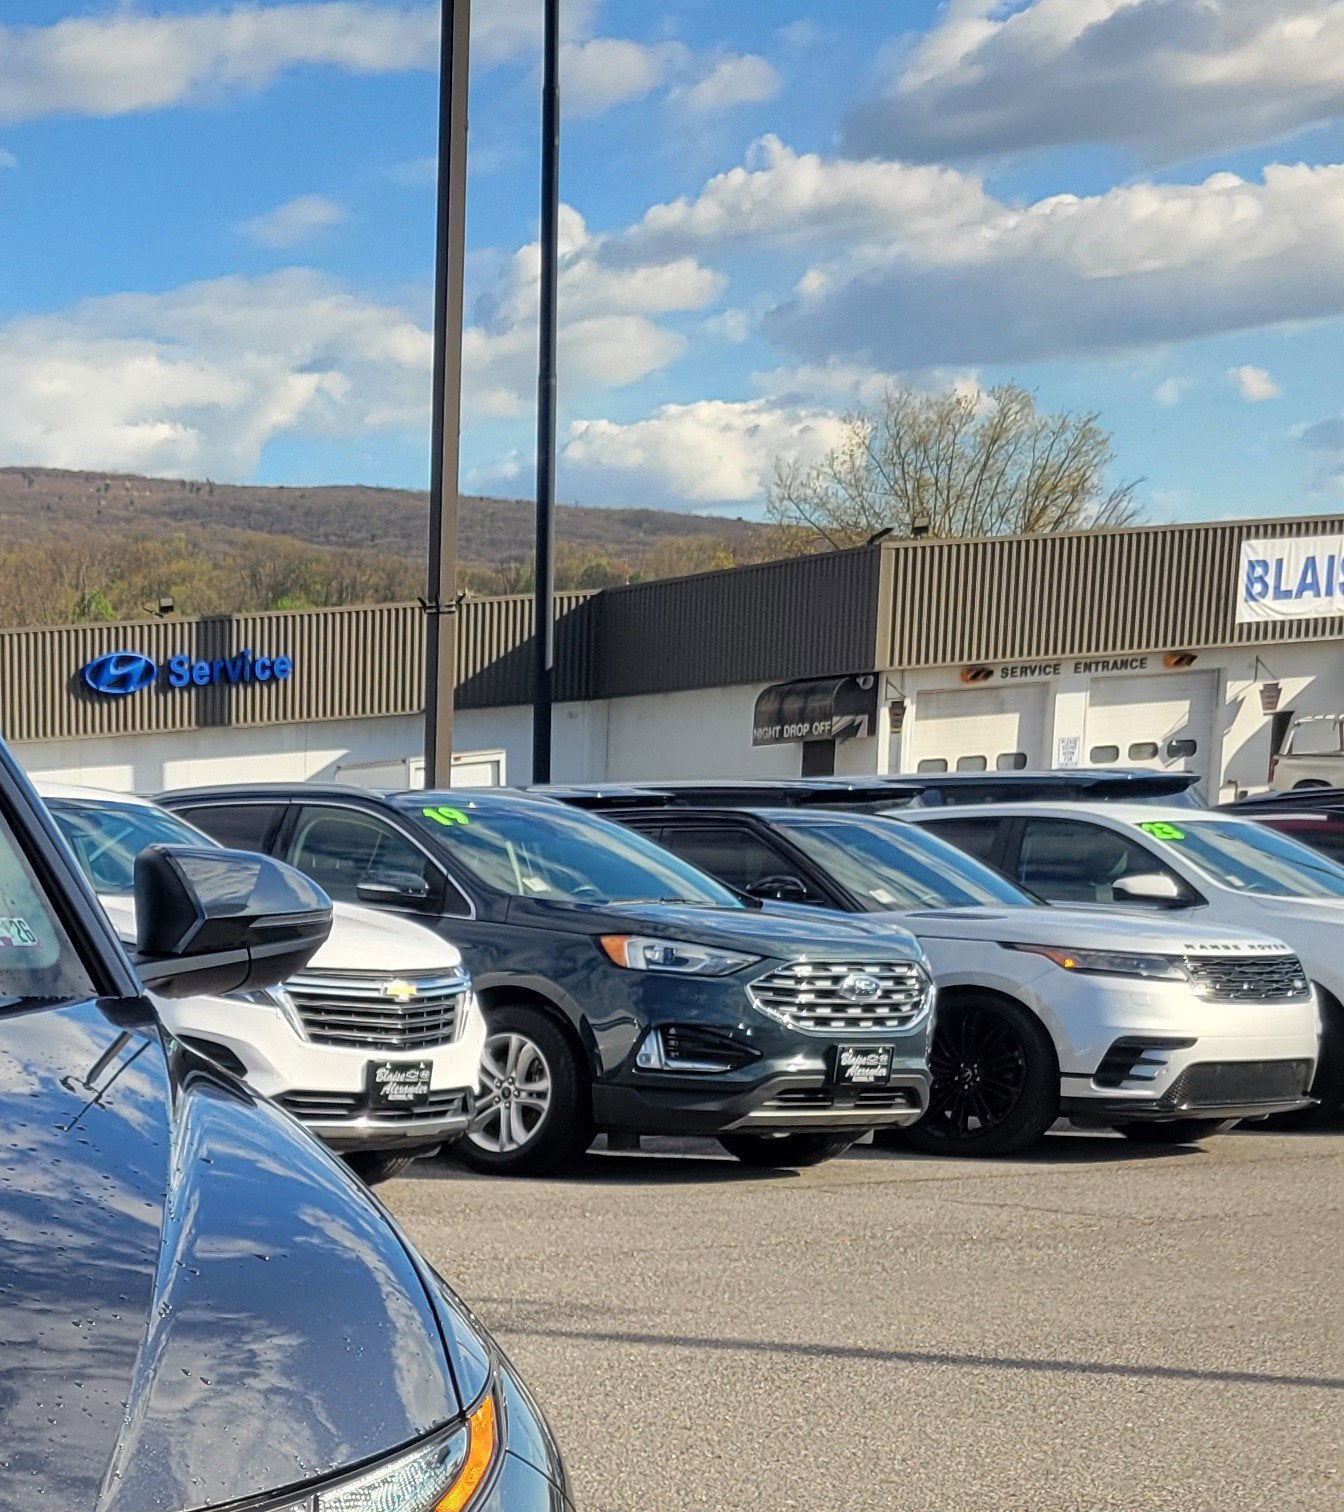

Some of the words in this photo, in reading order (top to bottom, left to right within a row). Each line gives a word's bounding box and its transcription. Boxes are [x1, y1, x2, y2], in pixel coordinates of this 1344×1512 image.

[1244, 554, 1344, 603] BLAI
[168, 648, 293, 688] Service
[1000, 663, 1061, 679] SERVICE
[1073, 657, 1148, 674] ENTRANCE
[754, 726, 781, 739] NIGHT
[783, 722, 809, 738] DROP
[812, 721, 832, 735] OFF
[422, 806, 469, 827] 19
[9, 920, 37, 943] 26
